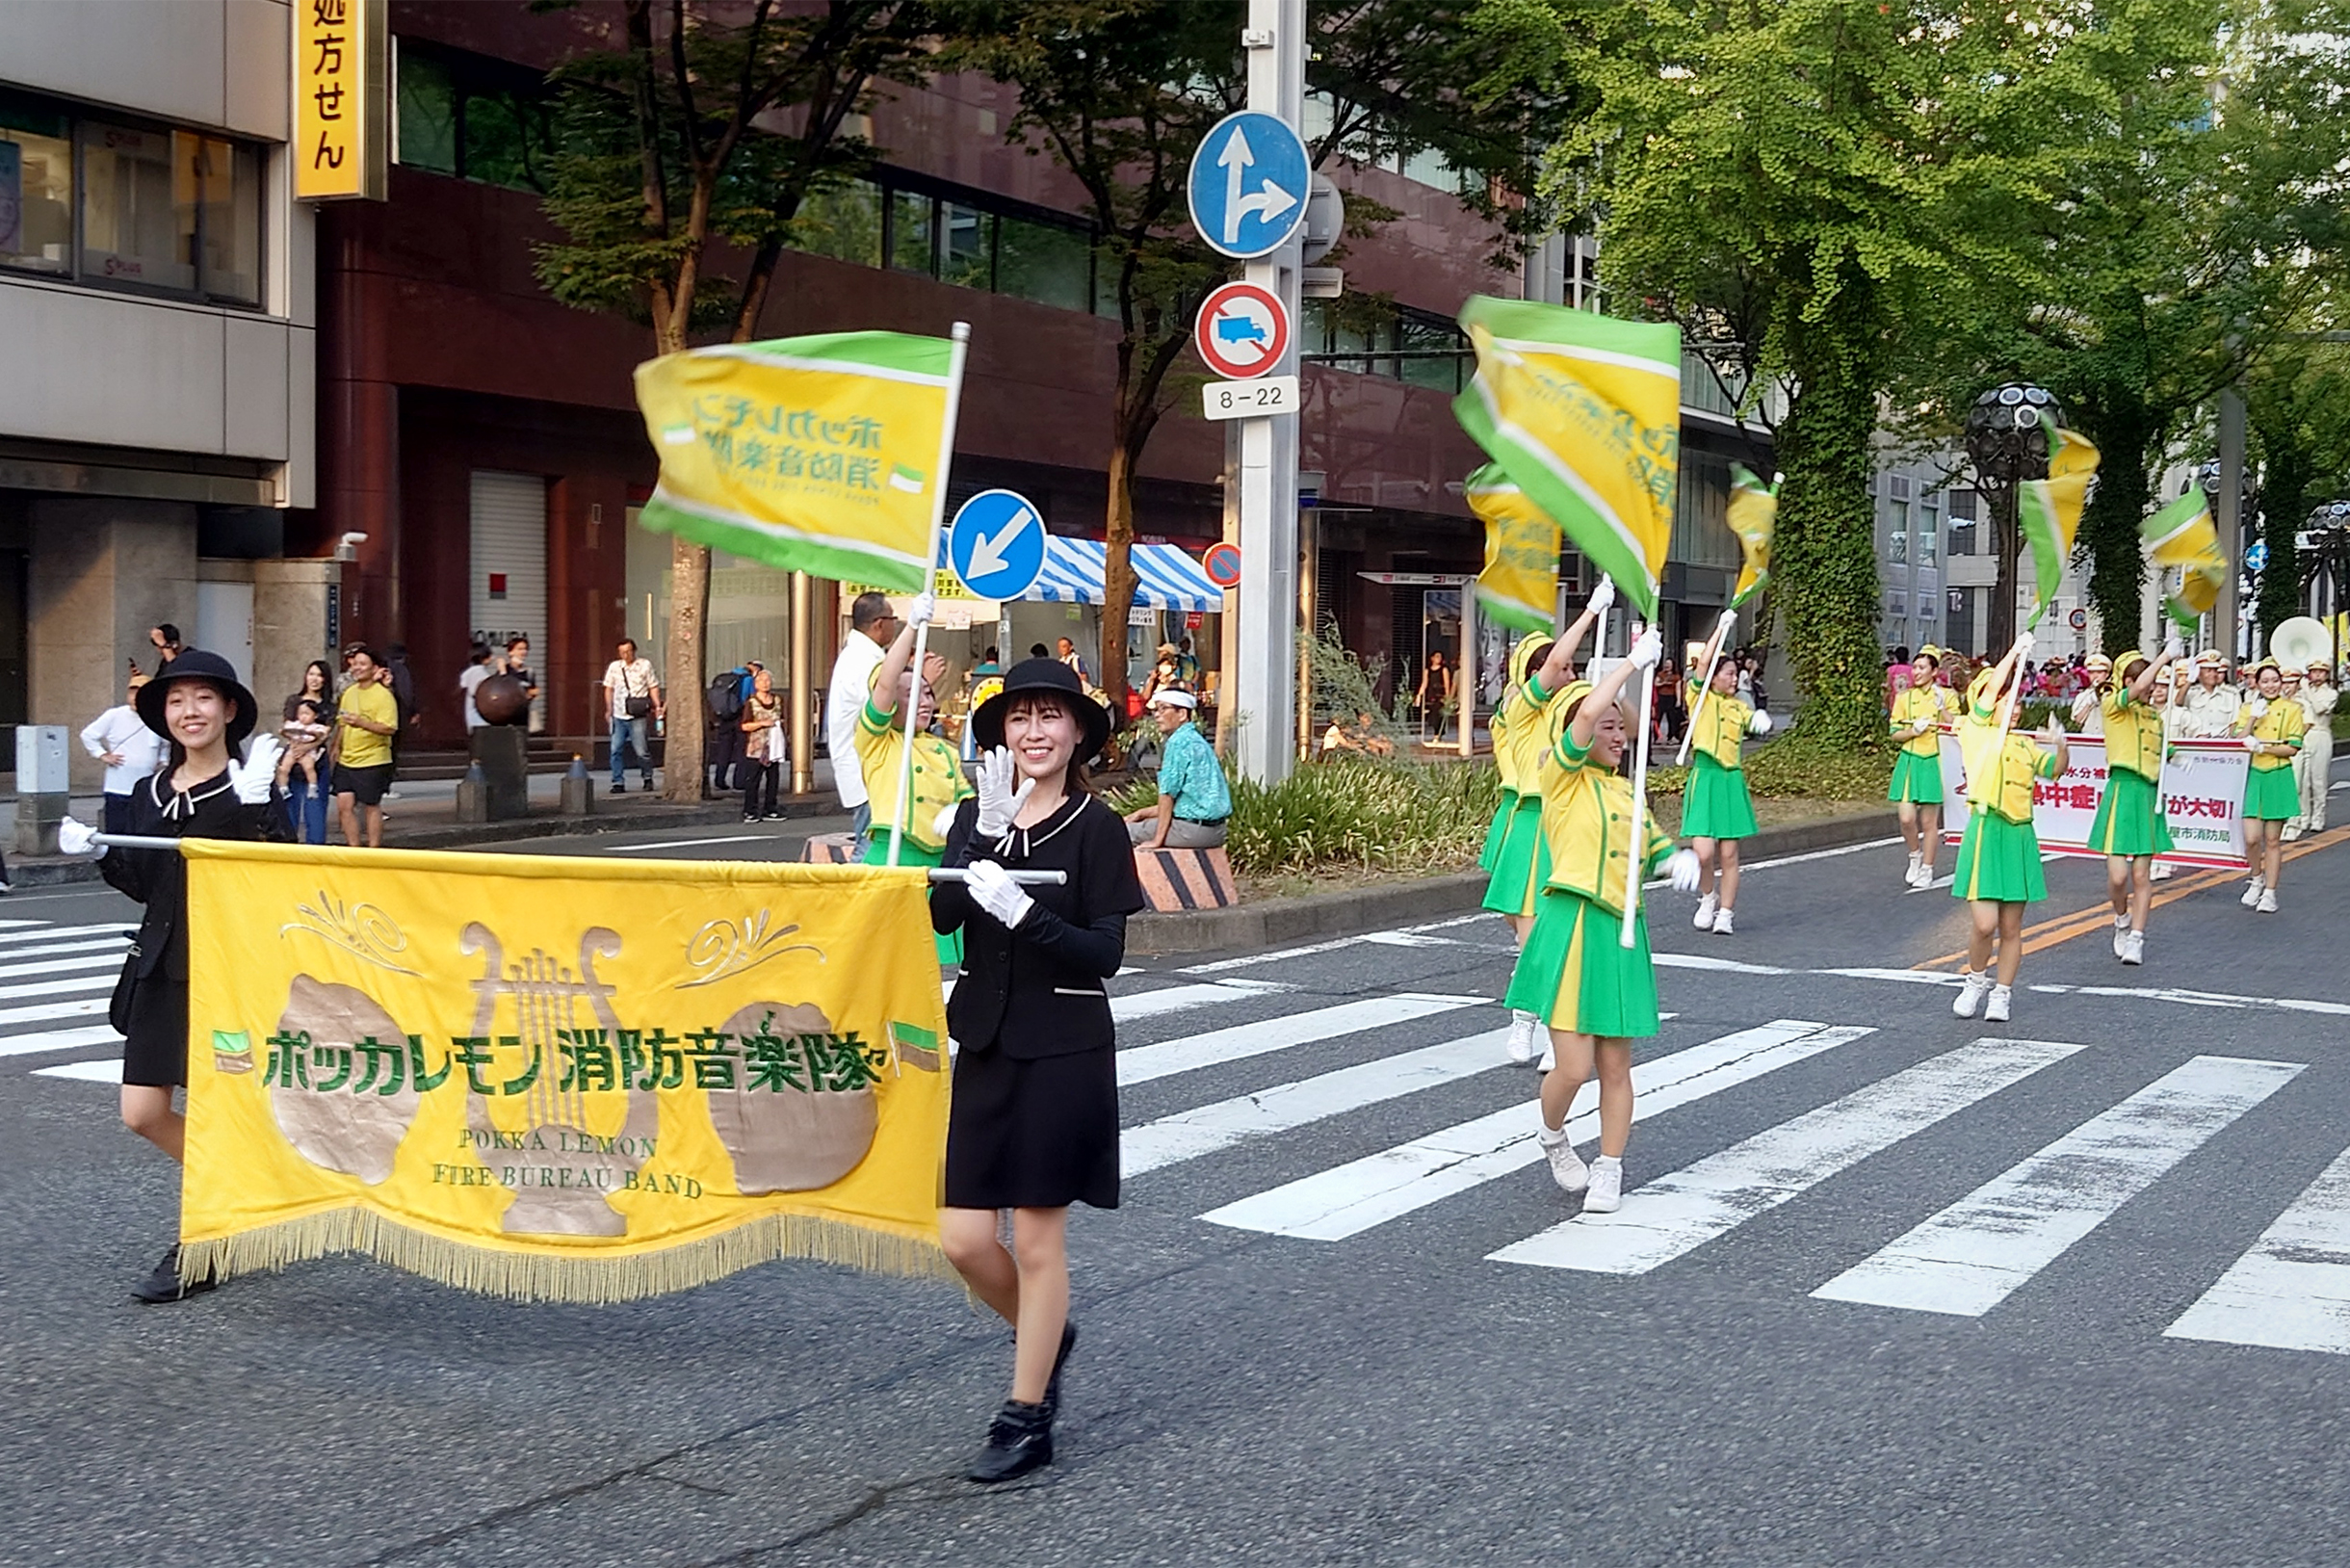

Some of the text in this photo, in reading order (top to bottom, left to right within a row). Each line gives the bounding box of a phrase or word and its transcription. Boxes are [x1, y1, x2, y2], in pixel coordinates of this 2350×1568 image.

[313, 0, 346, 170] 処方せん
[2066, 766, 2111, 780] 水分補
[2033, 781, 2233, 821] 中症 が大切!
[457, 1129, 658, 1158] POKKA LEMON
[432, 1163, 703, 1200] FIRE BUREAU BAND
